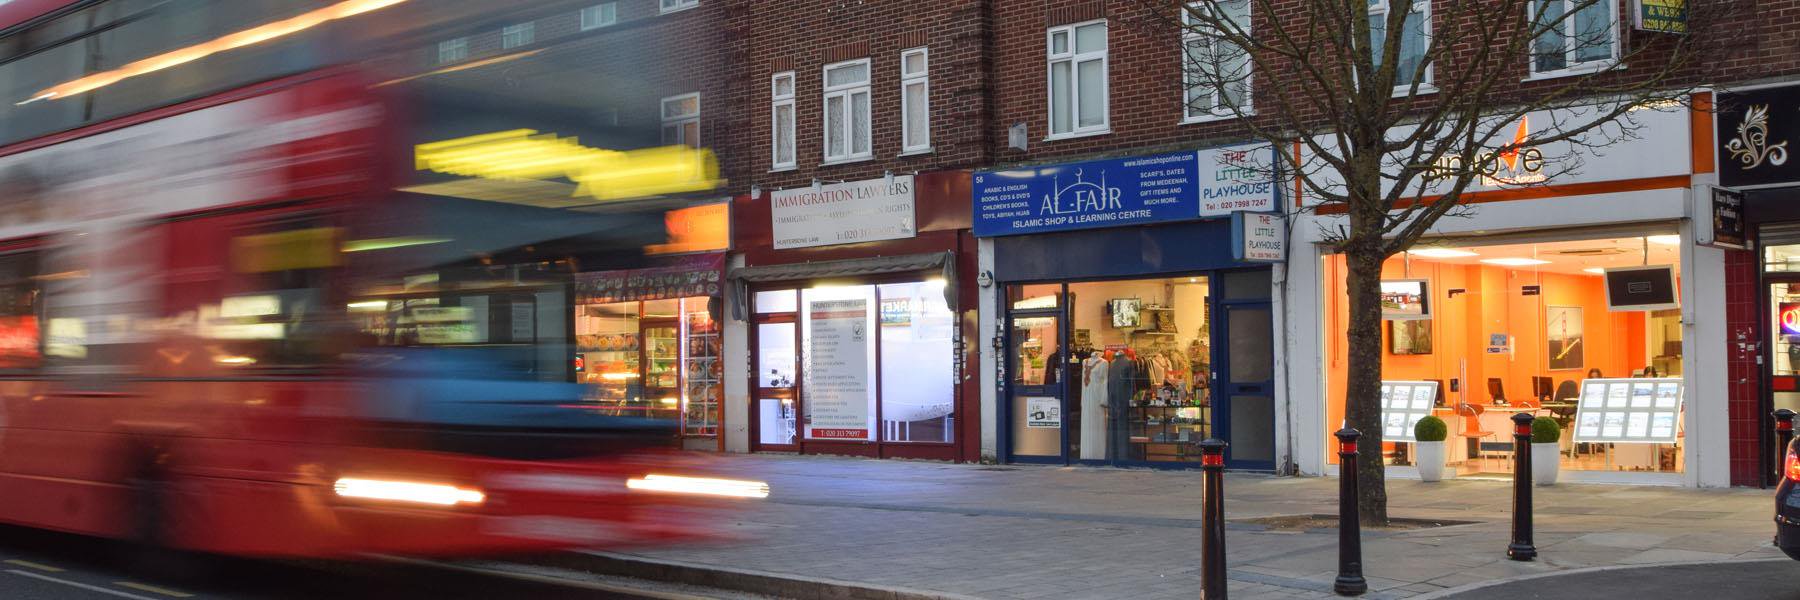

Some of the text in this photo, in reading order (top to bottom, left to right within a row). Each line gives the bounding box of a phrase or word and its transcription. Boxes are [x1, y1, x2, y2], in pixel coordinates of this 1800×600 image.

[1124, 155, 1193, 168] www.islamicshoponline.com
[1223, 151, 1247, 163] THE
[1166, 168, 1185, 176] DATES
[1216, 166, 1256, 182] LITTLE
[1007, 184, 1028, 192] ENGLISH
[1140, 180, 1156, 188] FROM
[775, 182, 909, 209] IMMIGRATION LAWYERS
[1152, 188, 1169, 196] ITEMS
[1204, 182, 1270, 199] PLAYHOUSE
[1144, 198, 1160, 206] MUCH
[1234, 200, 1250, 208] 7998
[1013, 209, 1152, 228] ISLAMIC SHOP & LEARNING CENTRE
[1259, 215, 1271, 225] THE
[844, 230, 858, 240] 020
[1254, 228, 1275, 238] LITTLE
[1249, 240, 1281, 250] PLAYHOUSE
[845, 430, 861, 438] 79097
